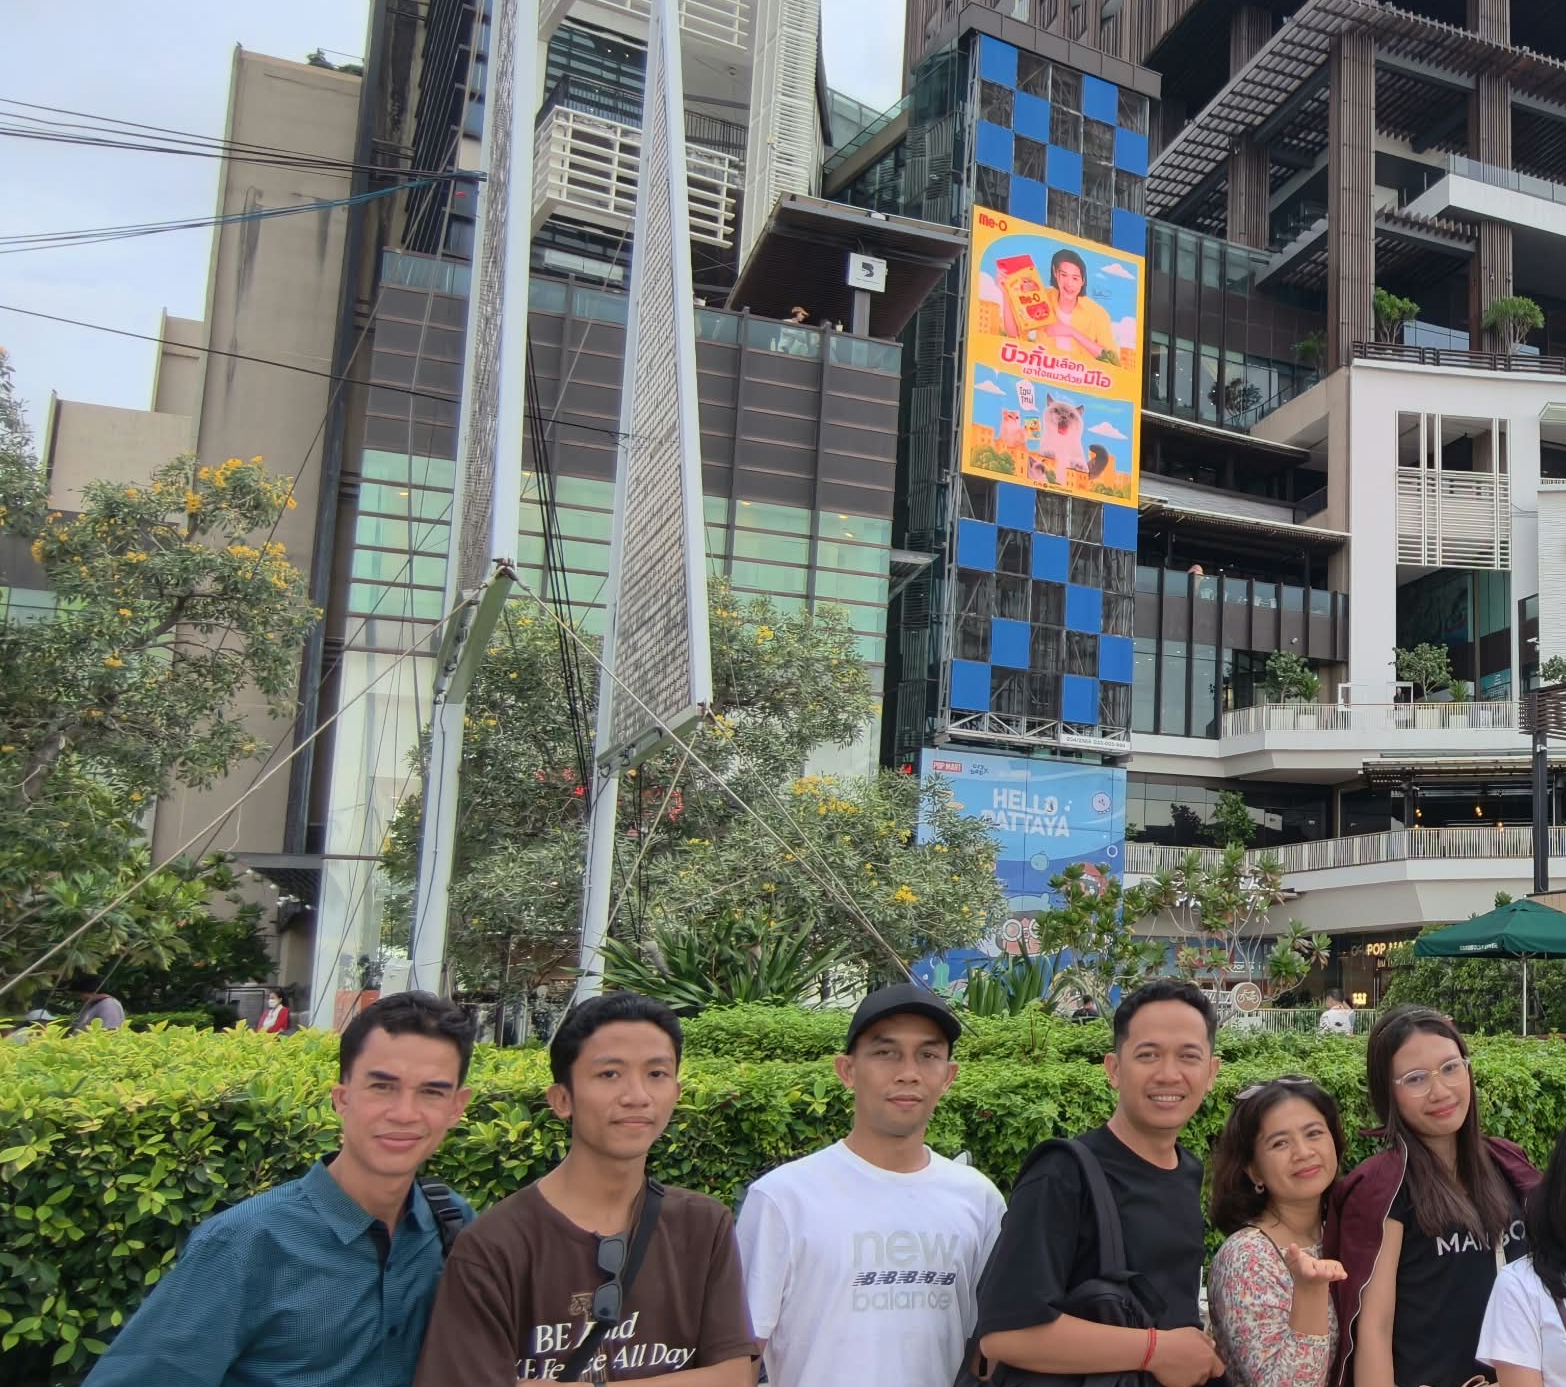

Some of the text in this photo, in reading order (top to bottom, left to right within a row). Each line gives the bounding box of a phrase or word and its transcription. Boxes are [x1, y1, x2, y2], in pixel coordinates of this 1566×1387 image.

[979, 213, 1008, 232] Me-O
[993, 788, 1058, 815] HELLO
[981, 810, 1070, 838] PATTAYA
[1366, 942, 1386, 956] POP
[852, 1230, 960, 1269] new
[535, 1322, 572, 1354] BE
[613, 1343, 647, 1370] All
[649, 1343, 697, 1370] Day
